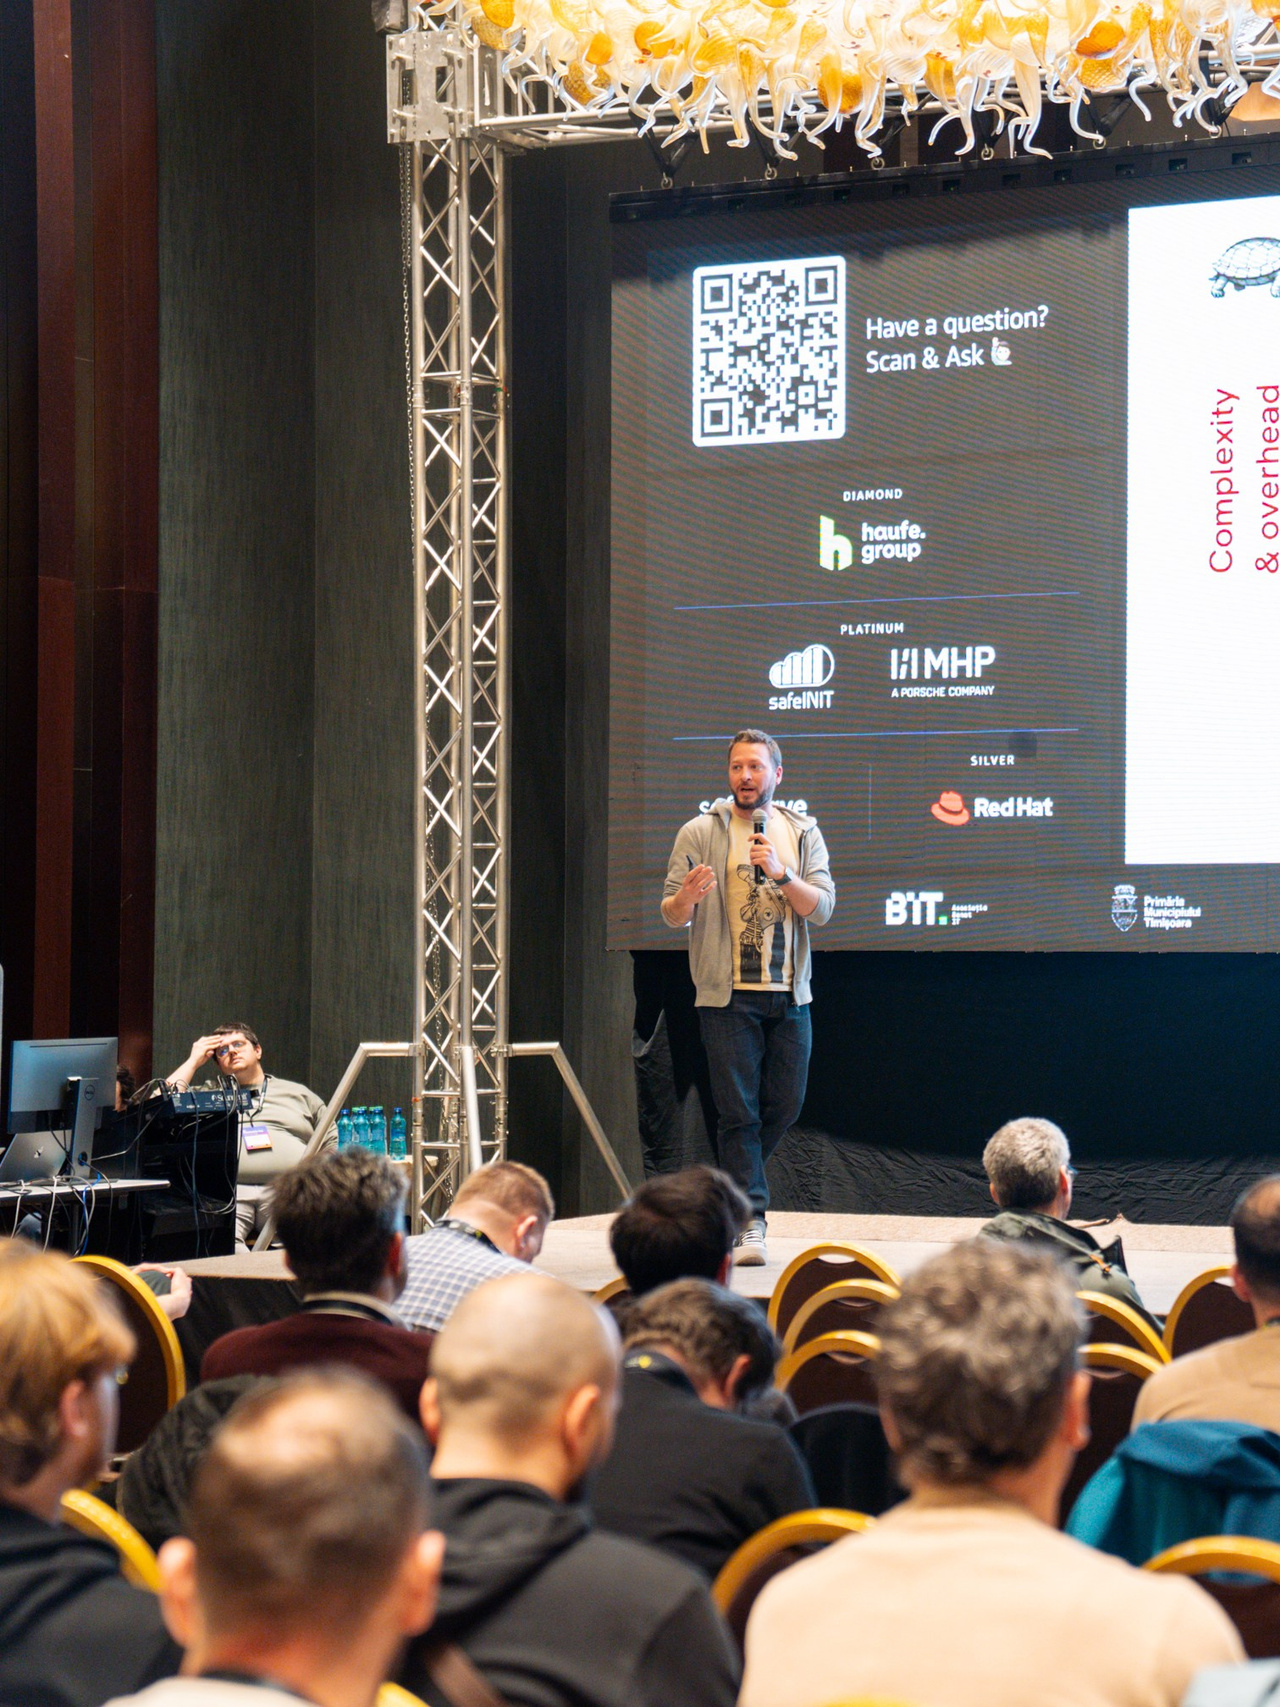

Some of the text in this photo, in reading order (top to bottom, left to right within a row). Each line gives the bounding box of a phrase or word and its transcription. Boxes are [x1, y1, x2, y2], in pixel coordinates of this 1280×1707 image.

[867, 304, 1049, 339] Have a question?
[867, 343, 985, 373] Scan & Ask
[1209, 389, 1239, 572] Complexity
[1255, 386, 1279, 573] & overhead
[843, 489, 902, 501] DIAMOND
[862, 520, 926, 541] haufe.
[861, 542, 921, 565] group
[841, 623, 904, 635] PLATINUM
[925, 646, 995, 679] MHP
[892, 686, 994, 697] A PORSCHE COMPANY
[971, 755, 1014, 766] SILVER
[974, 797, 1053, 817] Red Hat
